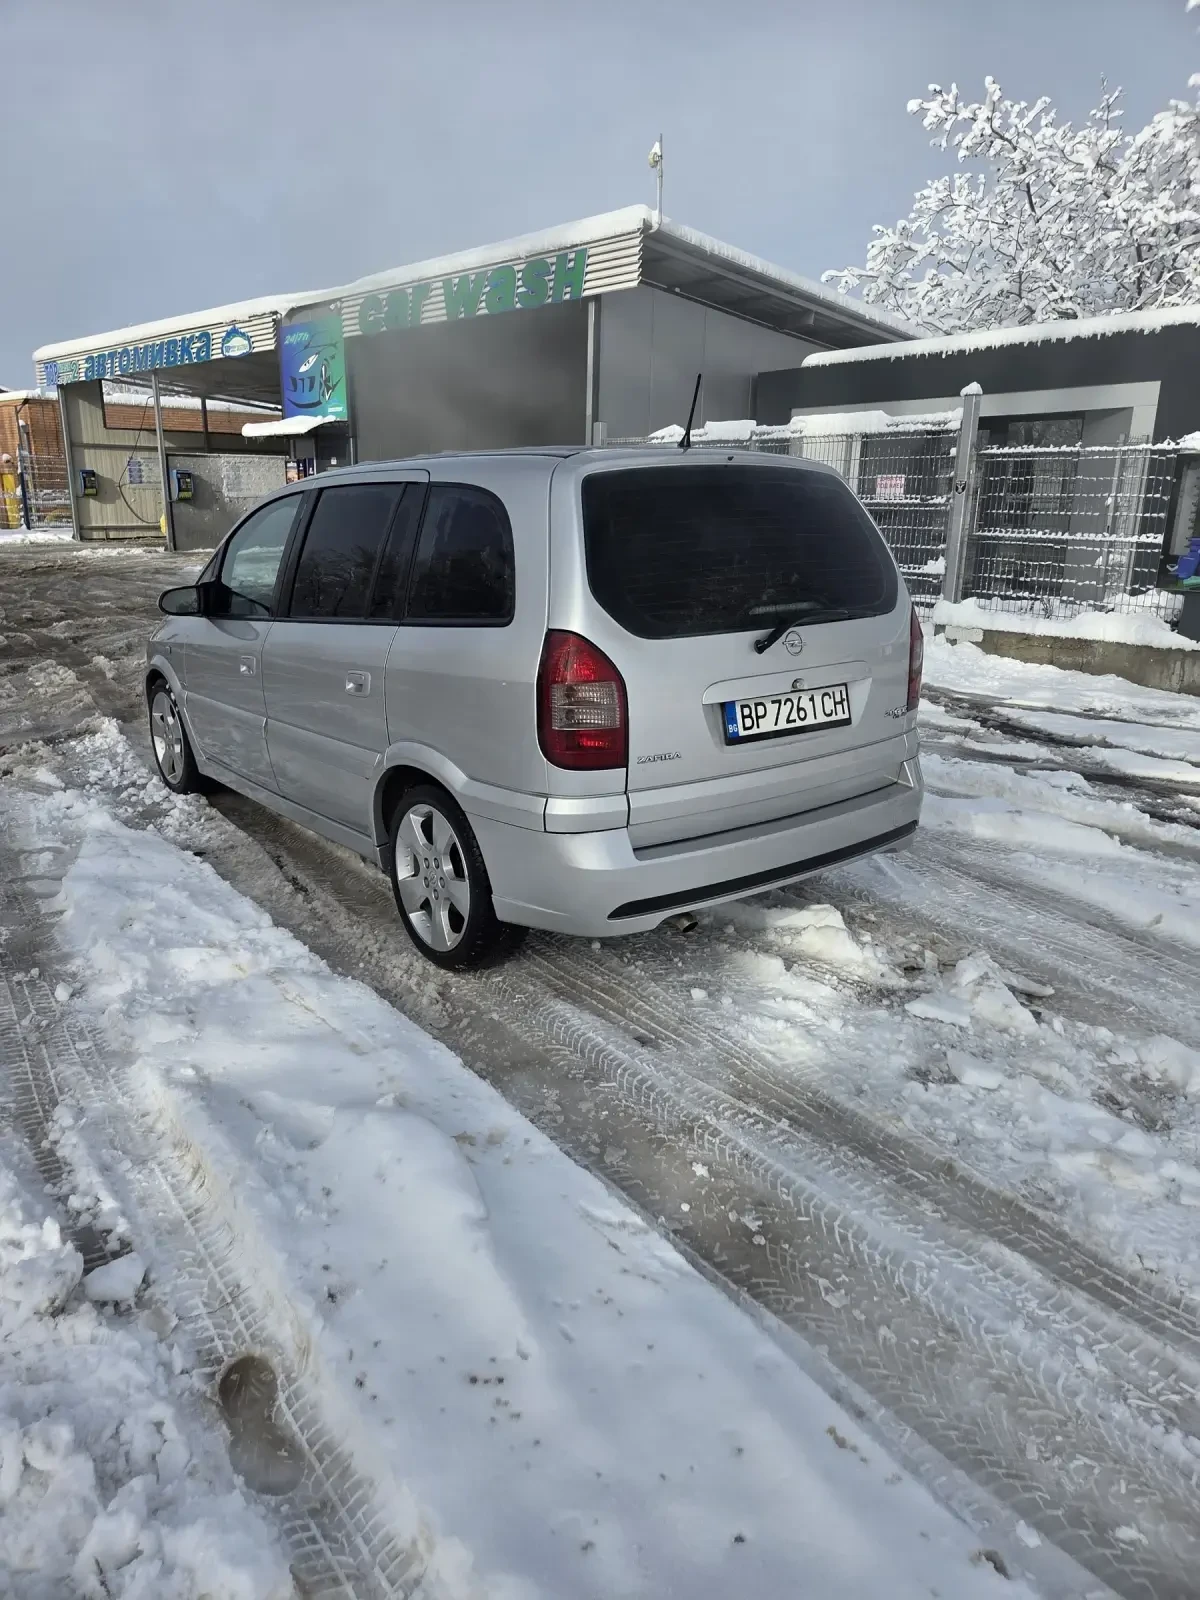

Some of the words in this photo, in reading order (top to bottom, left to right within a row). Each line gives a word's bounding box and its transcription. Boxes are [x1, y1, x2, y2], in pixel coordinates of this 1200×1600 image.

[84, 332, 212, 381] автомивка
[771, 693, 818, 727] 7261
[728, 723, 738, 733] BG
[636, 751, 682, 764] ZAFIRA
